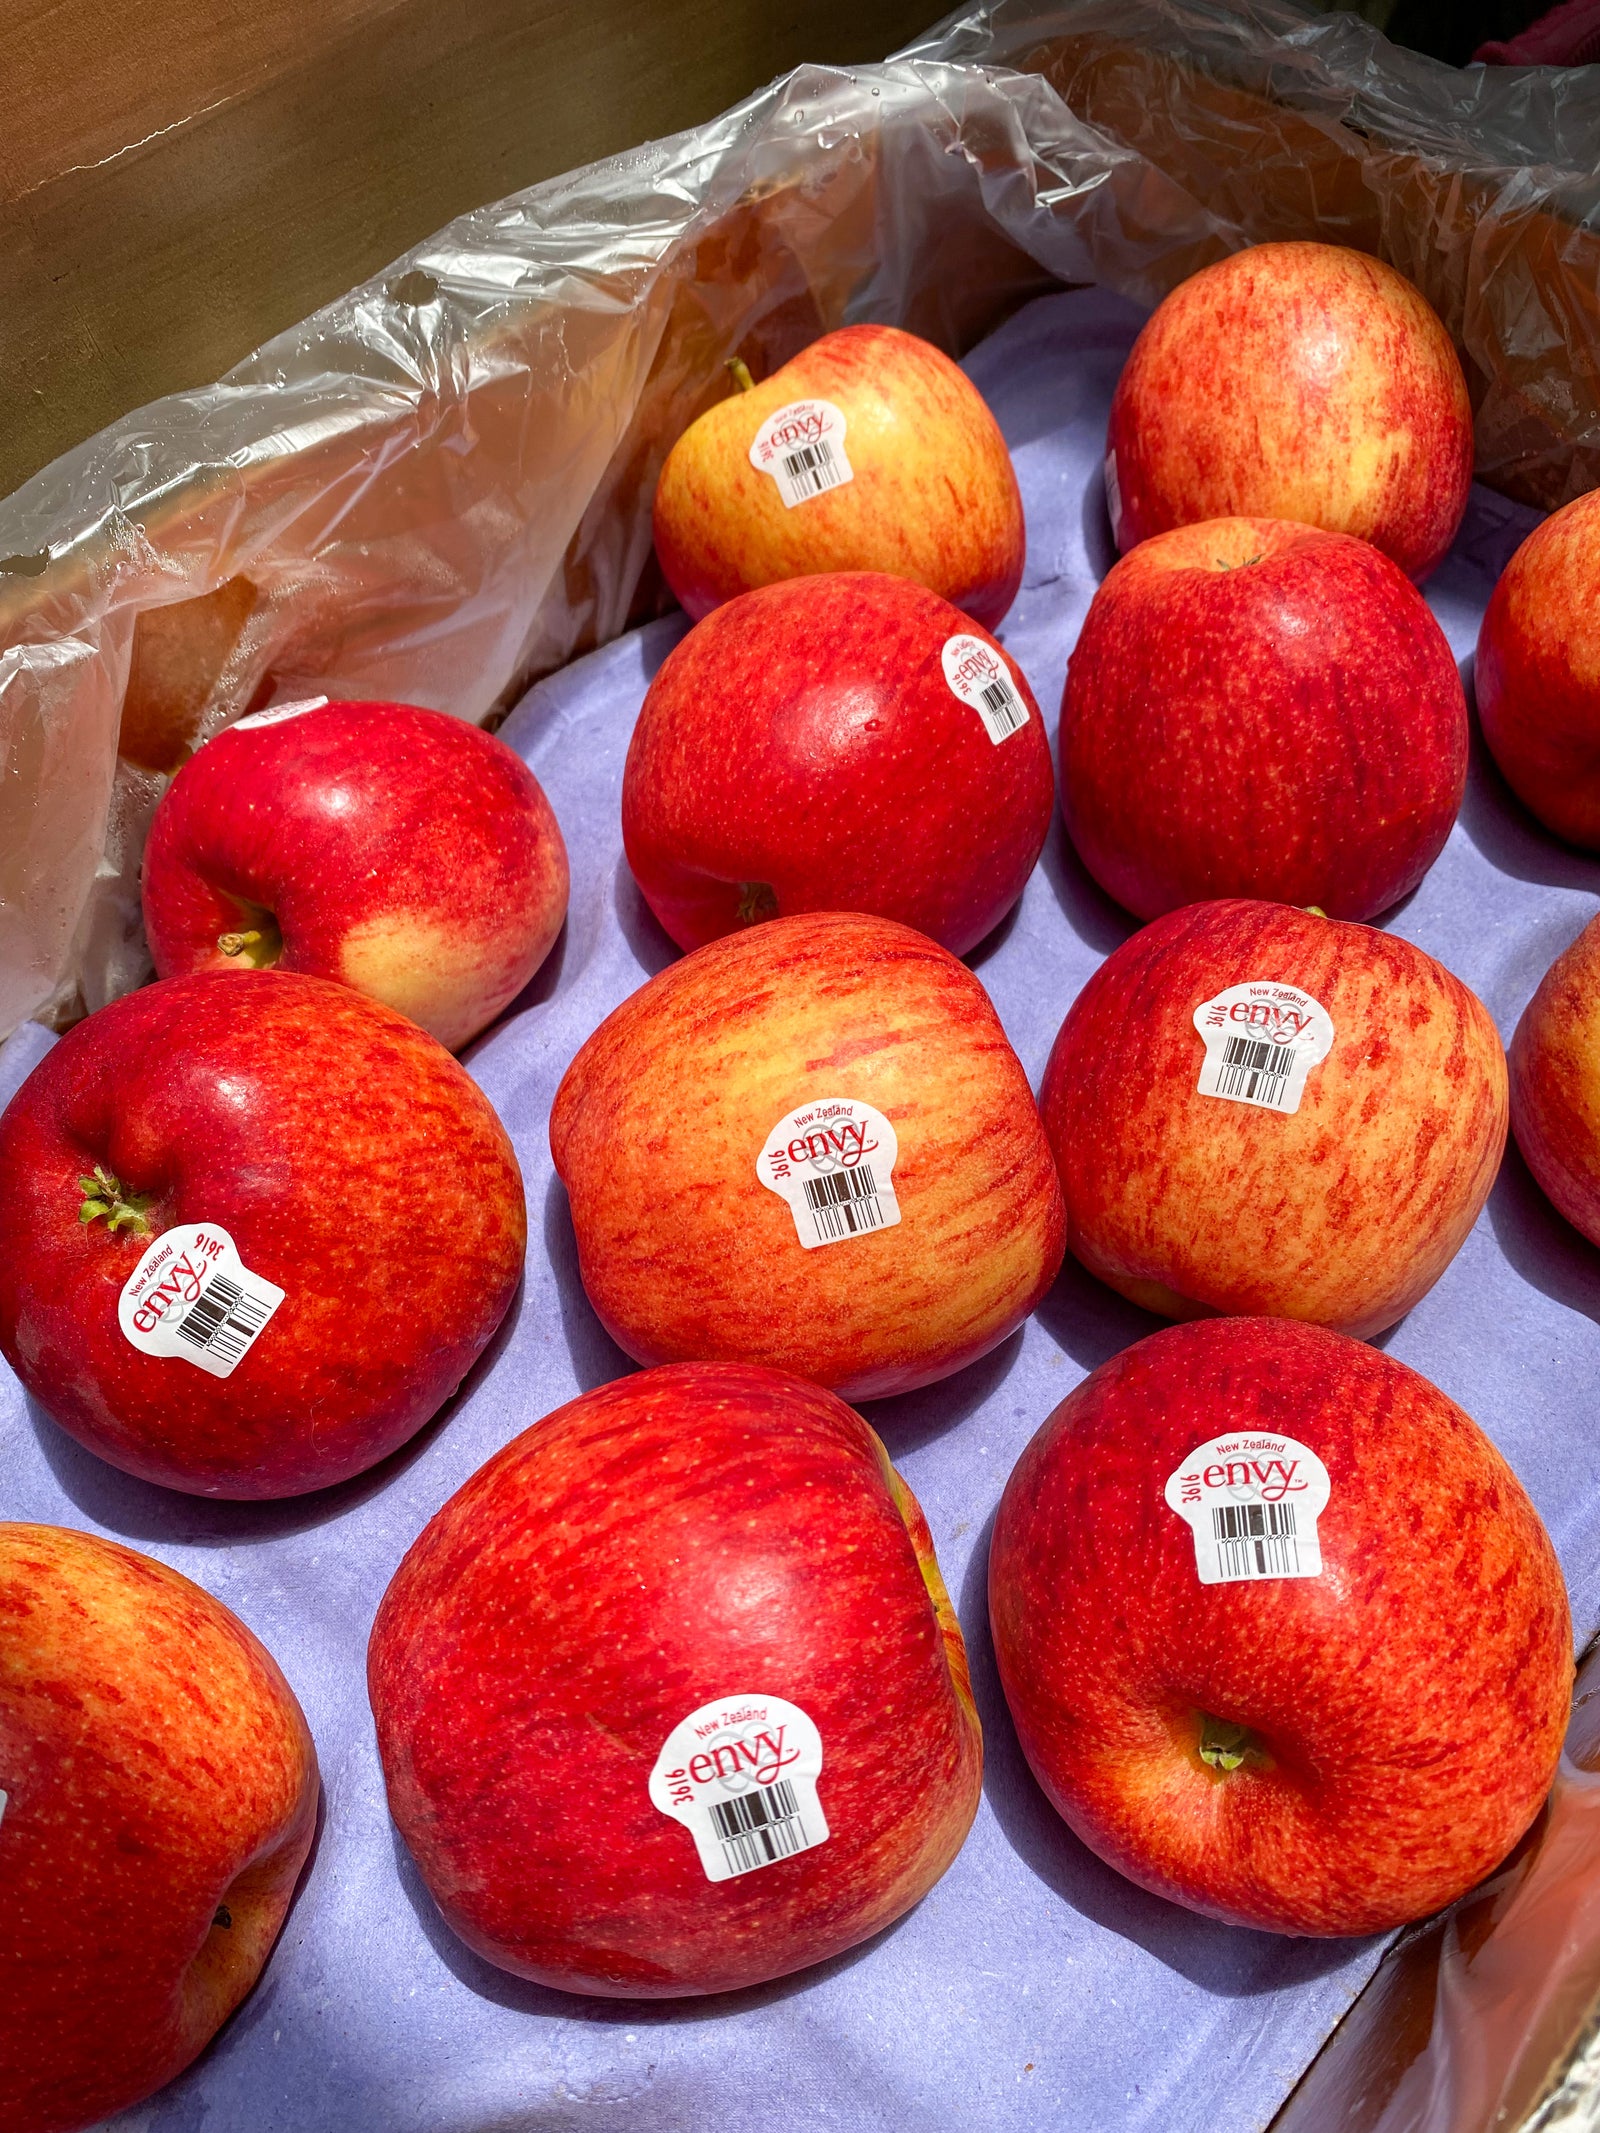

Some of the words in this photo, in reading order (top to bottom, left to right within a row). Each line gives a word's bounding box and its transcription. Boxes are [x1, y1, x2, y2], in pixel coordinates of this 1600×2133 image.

[771, 411, 833, 447] envy
[958, 648, 999, 680] envy
[952, 673, 972, 695] 3616
[1249, 987, 1270, 996] New
[1272, 988, 1309, 1007] Zealand
[1206, 1005, 1228, 1027] 3616
[1229, 1002, 1315, 1045] envy
[793, 1113, 814, 1128] New
[815, 1105, 854, 1119] Zealand
[787, 1119, 879, 1168] envy
[768, 1150, 792, 1180] 3616
[193, 1233, 225, 1262] 3616
[128, 1277, 148, 1297] New
[142, 1243, 174, 1277] Zealand
[132, 1250, 208, 1334] envy
[1216, 1441, 1240, 1456] New
[1242, 1439, 1287, 1453] Zealand
[1180, 1474, 1202, 1504] 3616
[1203, 1459, 1309, 1502] envy
[694, 1723, 720, 1740] New
[721, 1707, 768, 1726] Zealand
[688, 1724, 801, 1785] envy
[664, 1768, 694, 1806] 3616
